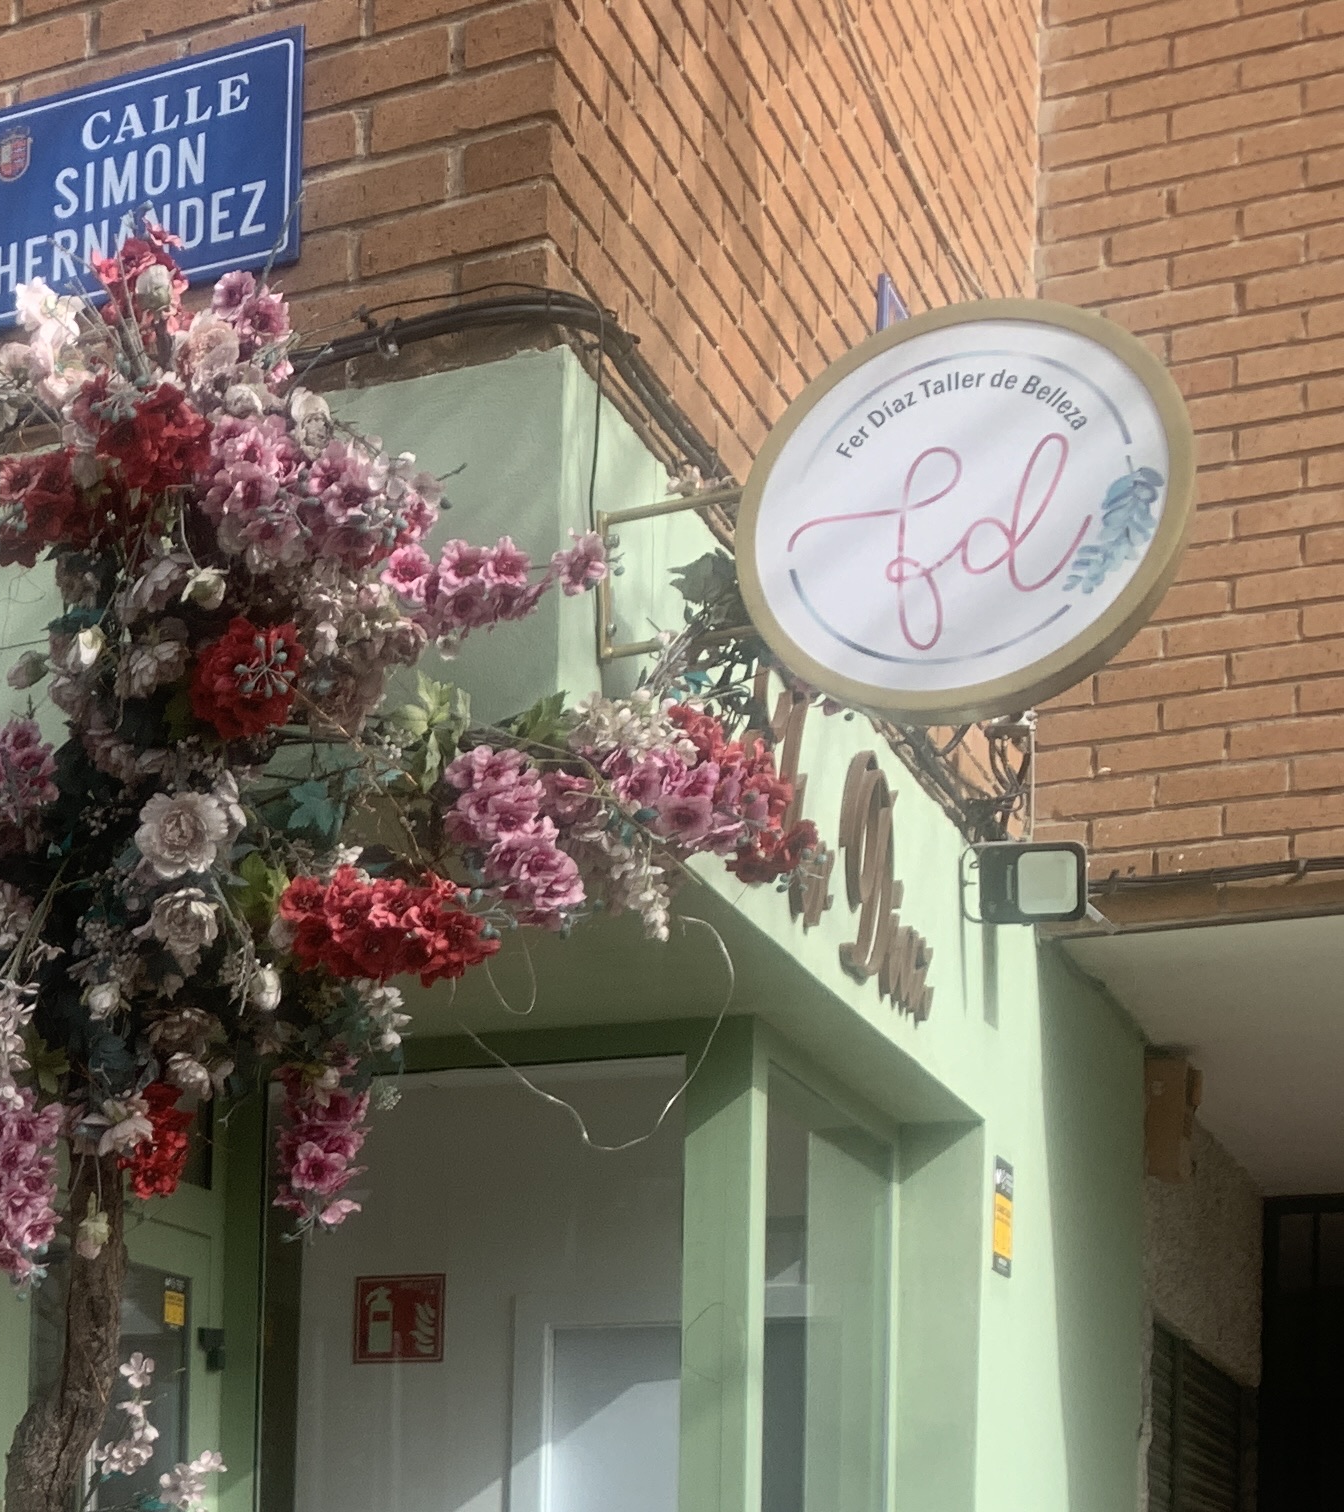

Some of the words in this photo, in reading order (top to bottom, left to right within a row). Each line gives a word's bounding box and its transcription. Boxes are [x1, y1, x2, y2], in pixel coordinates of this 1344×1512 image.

[81, 72, 251, 151] CALLE
[53, 131, 207, 220] SIMON
[835, 425, 870, 459] Fer
[867, 390, 918, 429] Díaz
[918, 370, 986, 399] Taller
[989, 368, 1018, 391] de
[1021, 374, 1089, 432] Belleza
